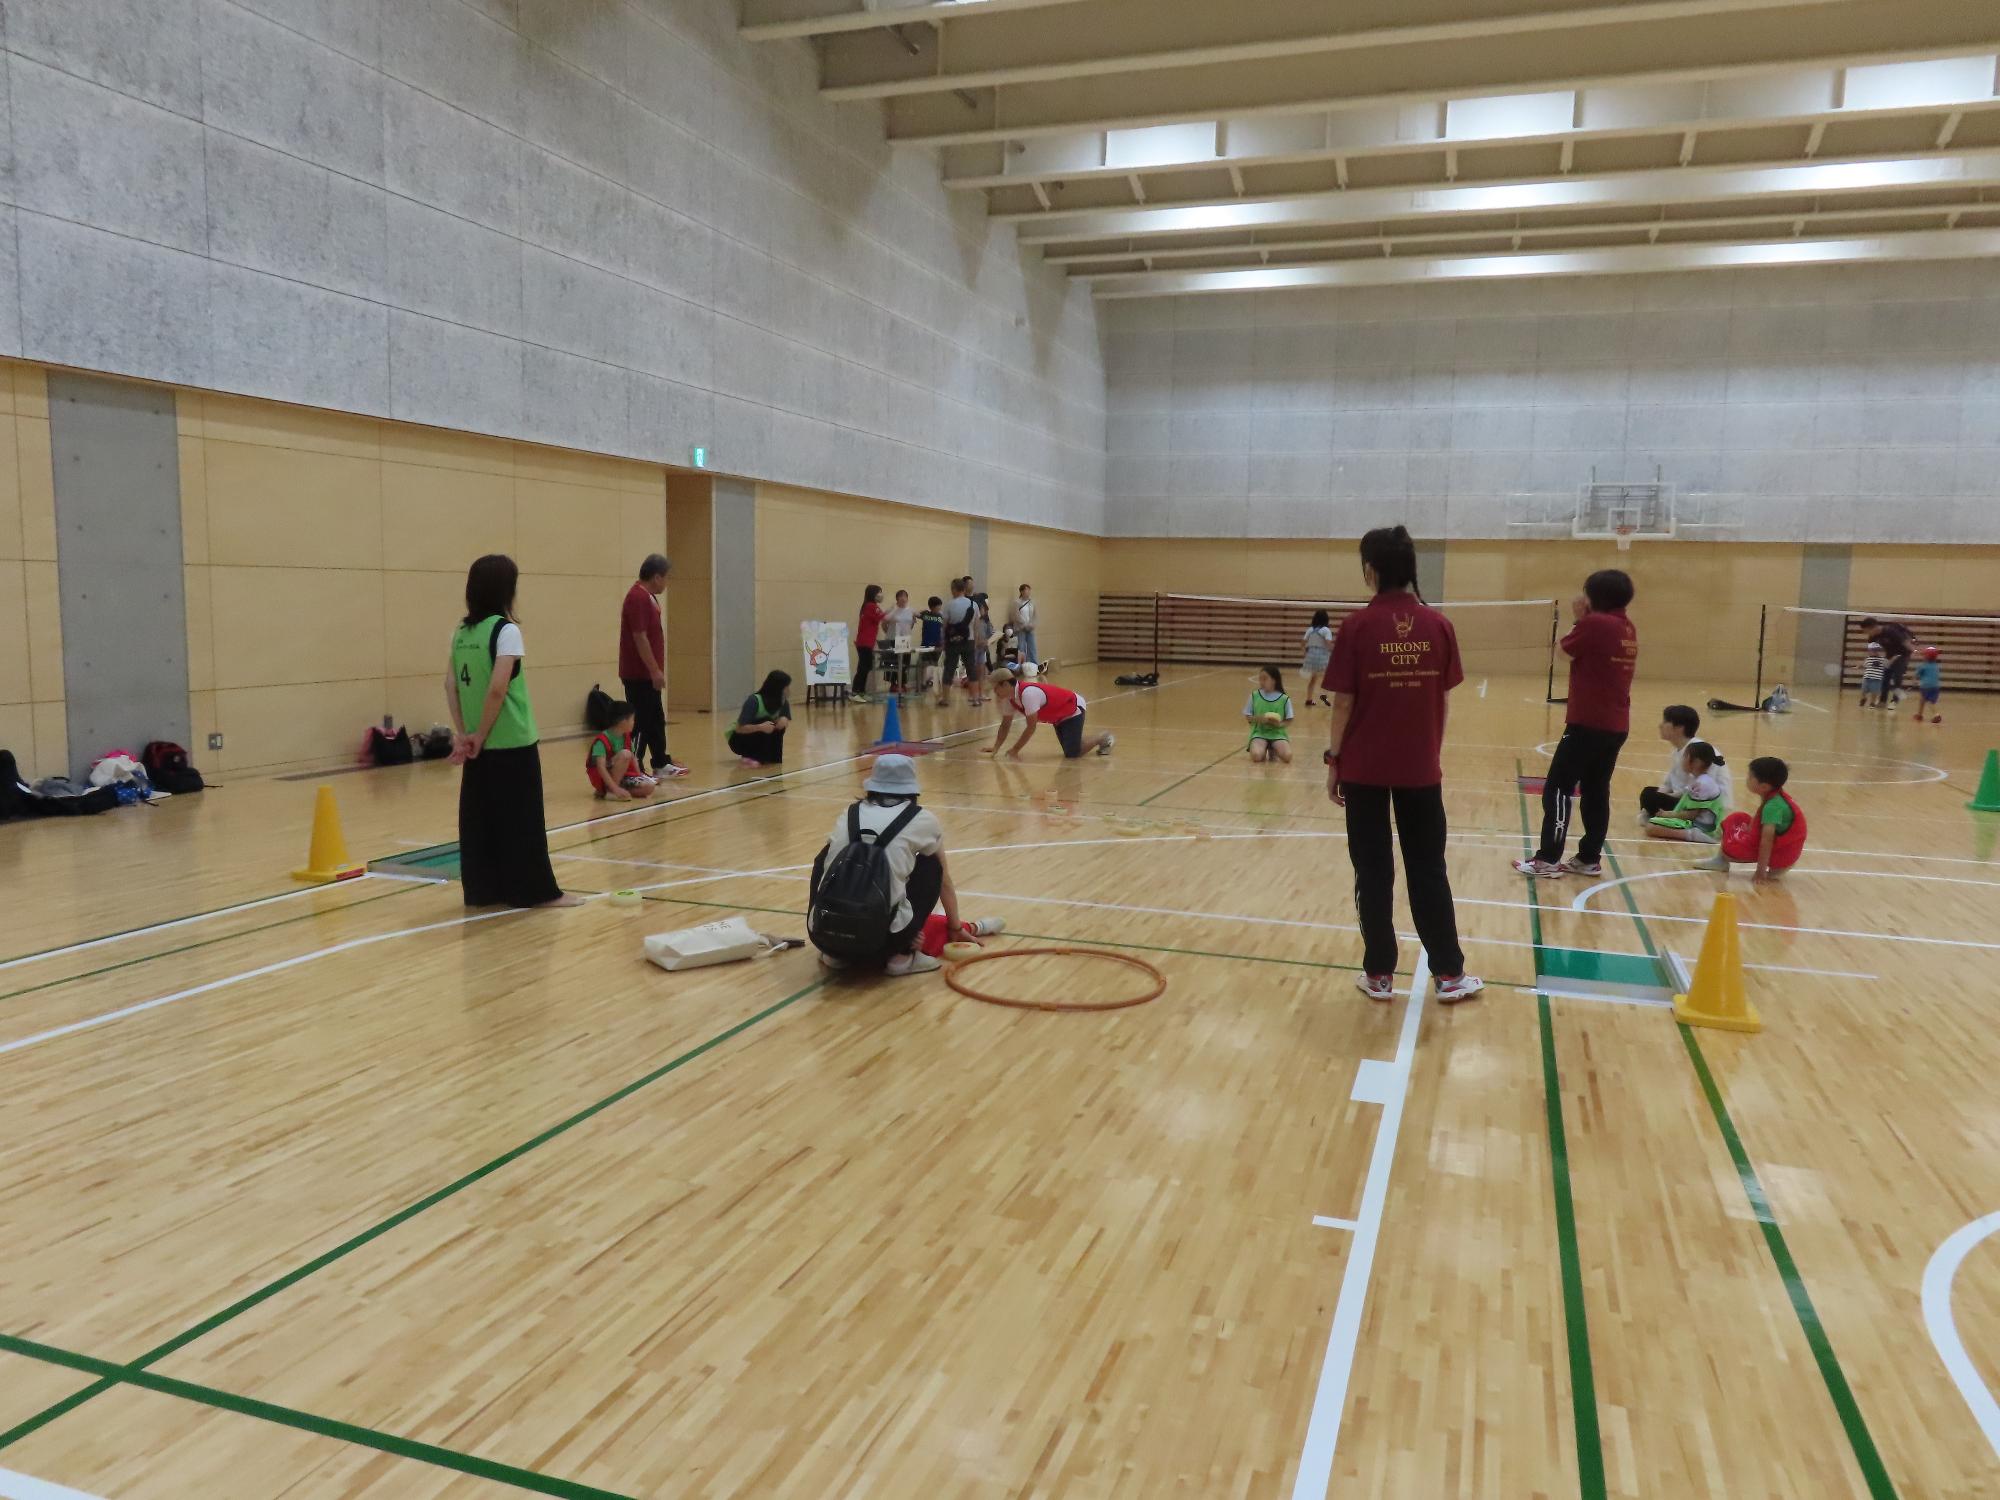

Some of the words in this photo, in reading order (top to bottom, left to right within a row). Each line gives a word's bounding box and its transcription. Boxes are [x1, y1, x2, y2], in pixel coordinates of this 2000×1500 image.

[1380, 641, 1431, 653] HIKONE
[1391, 654, 1420, 665] CITY
[460, 663, 472, 687] 4
